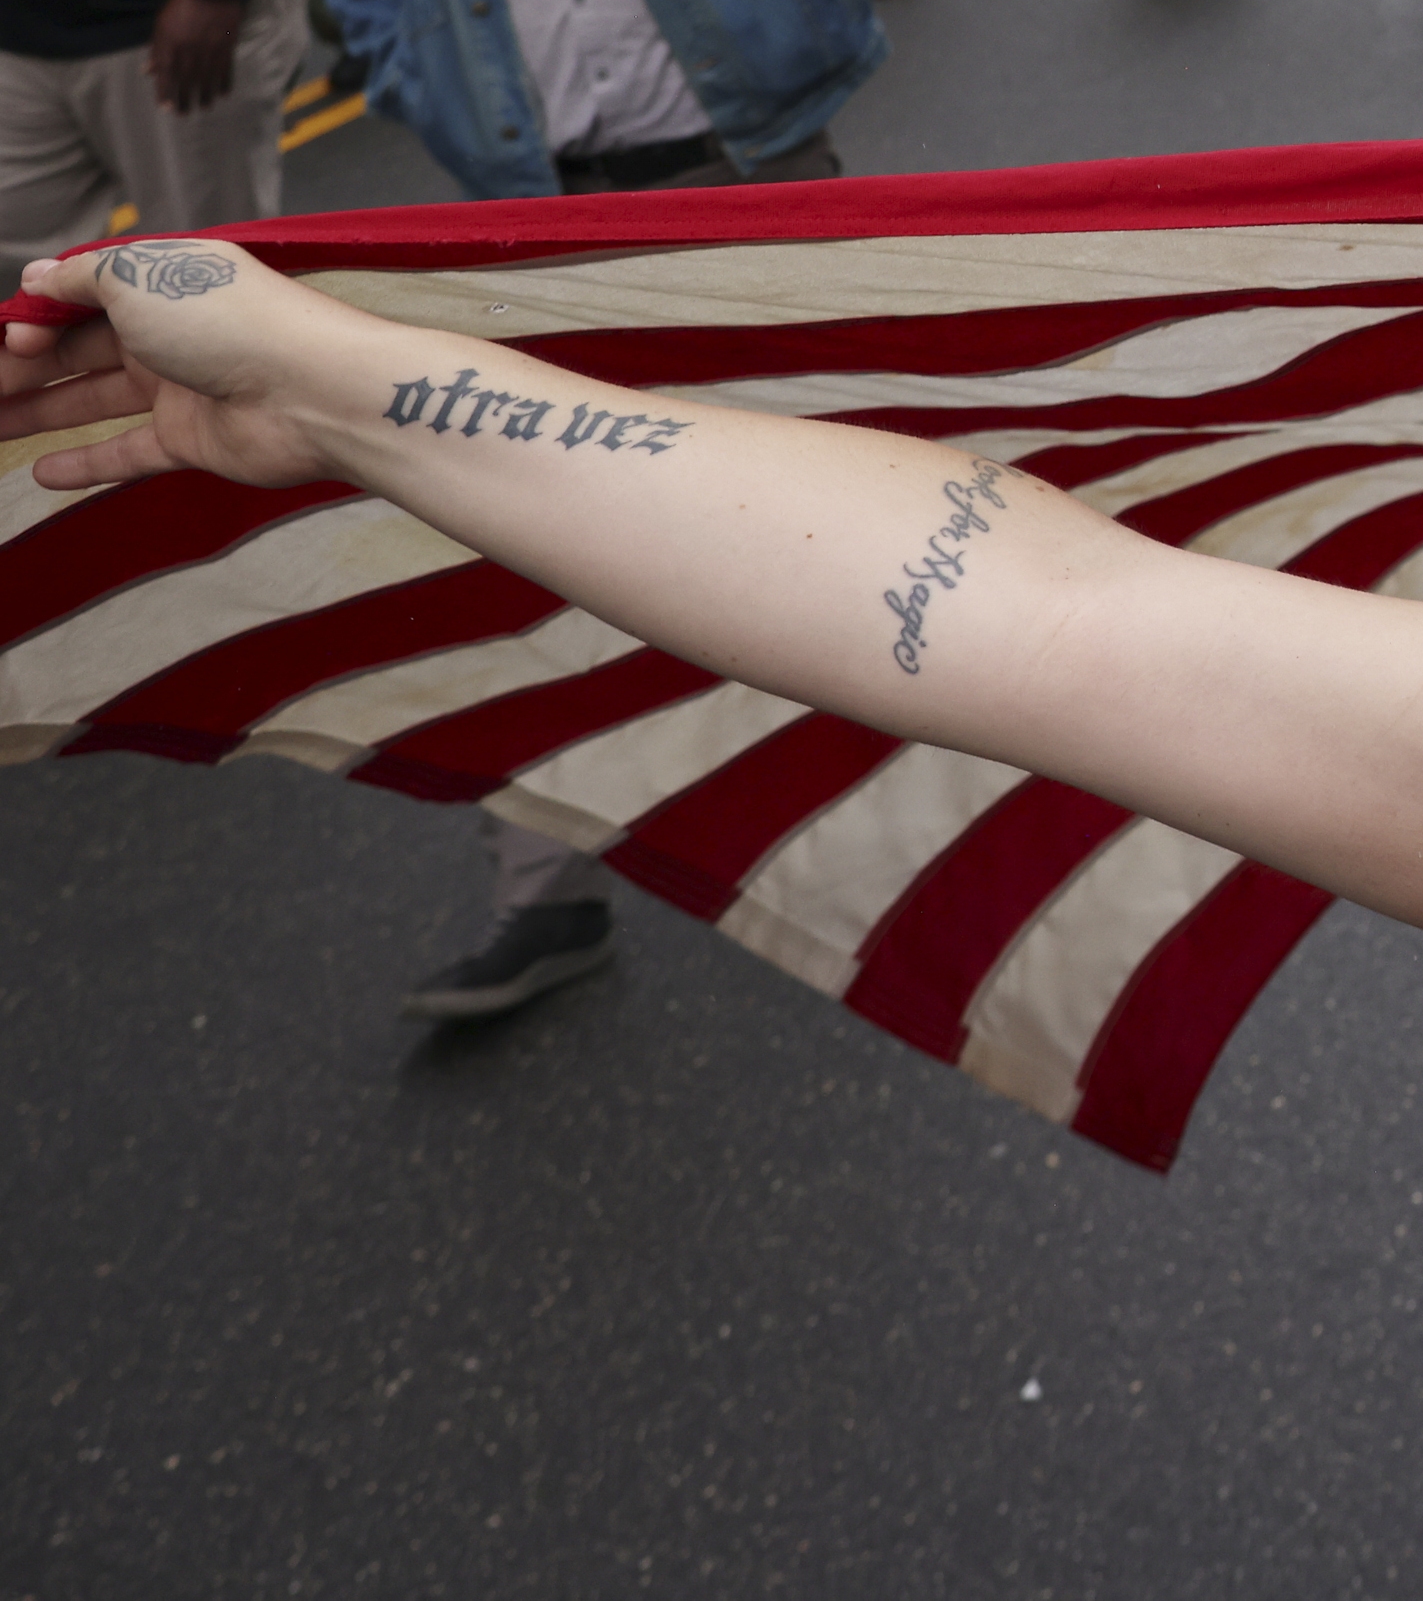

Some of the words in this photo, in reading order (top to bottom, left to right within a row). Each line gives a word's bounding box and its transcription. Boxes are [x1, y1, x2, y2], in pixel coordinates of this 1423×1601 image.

[383, 368, 557, 441] otra
[554, 402, 697, 456] vez
[940, 481, 990, 542] for
